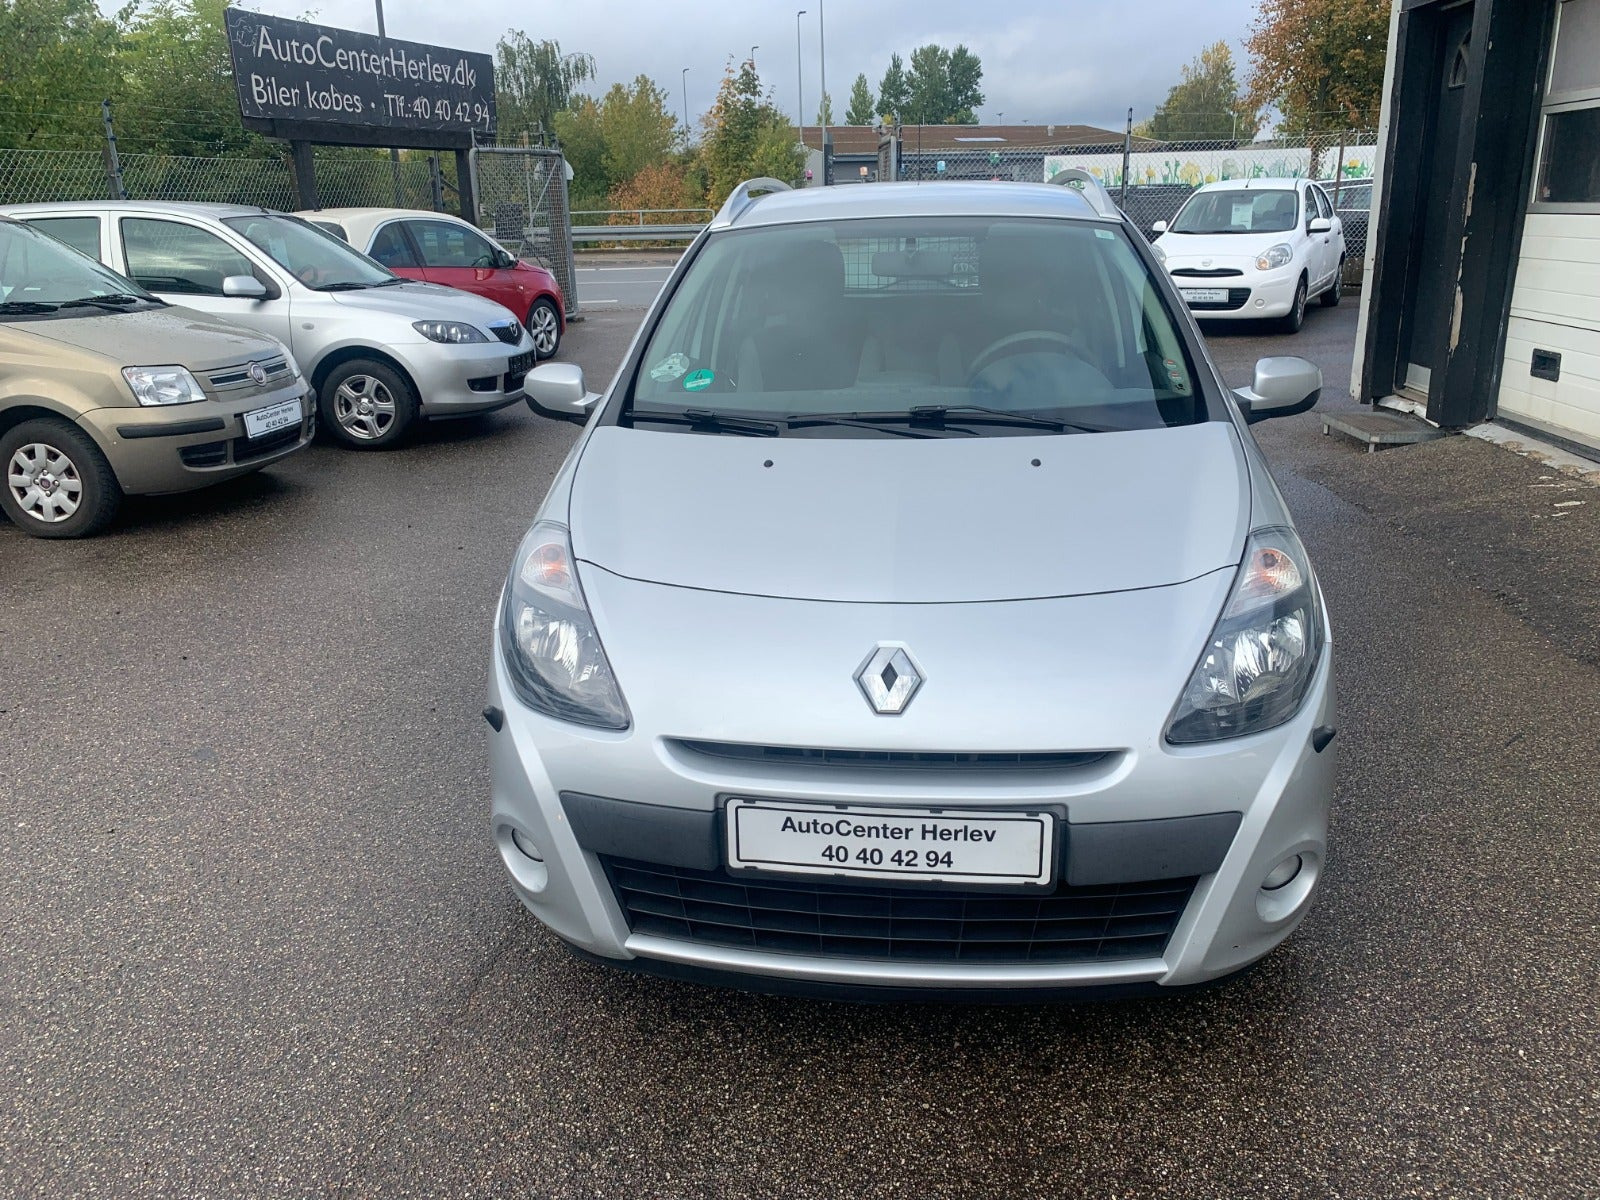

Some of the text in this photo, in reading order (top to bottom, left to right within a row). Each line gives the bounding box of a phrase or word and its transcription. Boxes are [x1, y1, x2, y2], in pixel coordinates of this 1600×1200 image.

[256, 25, 476, 88] AutoCenterHerlev.dk
[306, 81, 362, 113] købes
[435, 99, 451, 121] 40
[455, 102, 471, 122] 42
[474, 102, 490, 127] 94
[781, 816, 997, 843] AutoCenter Herlev
[821, 844, 954, 868] 40 40 42 94
